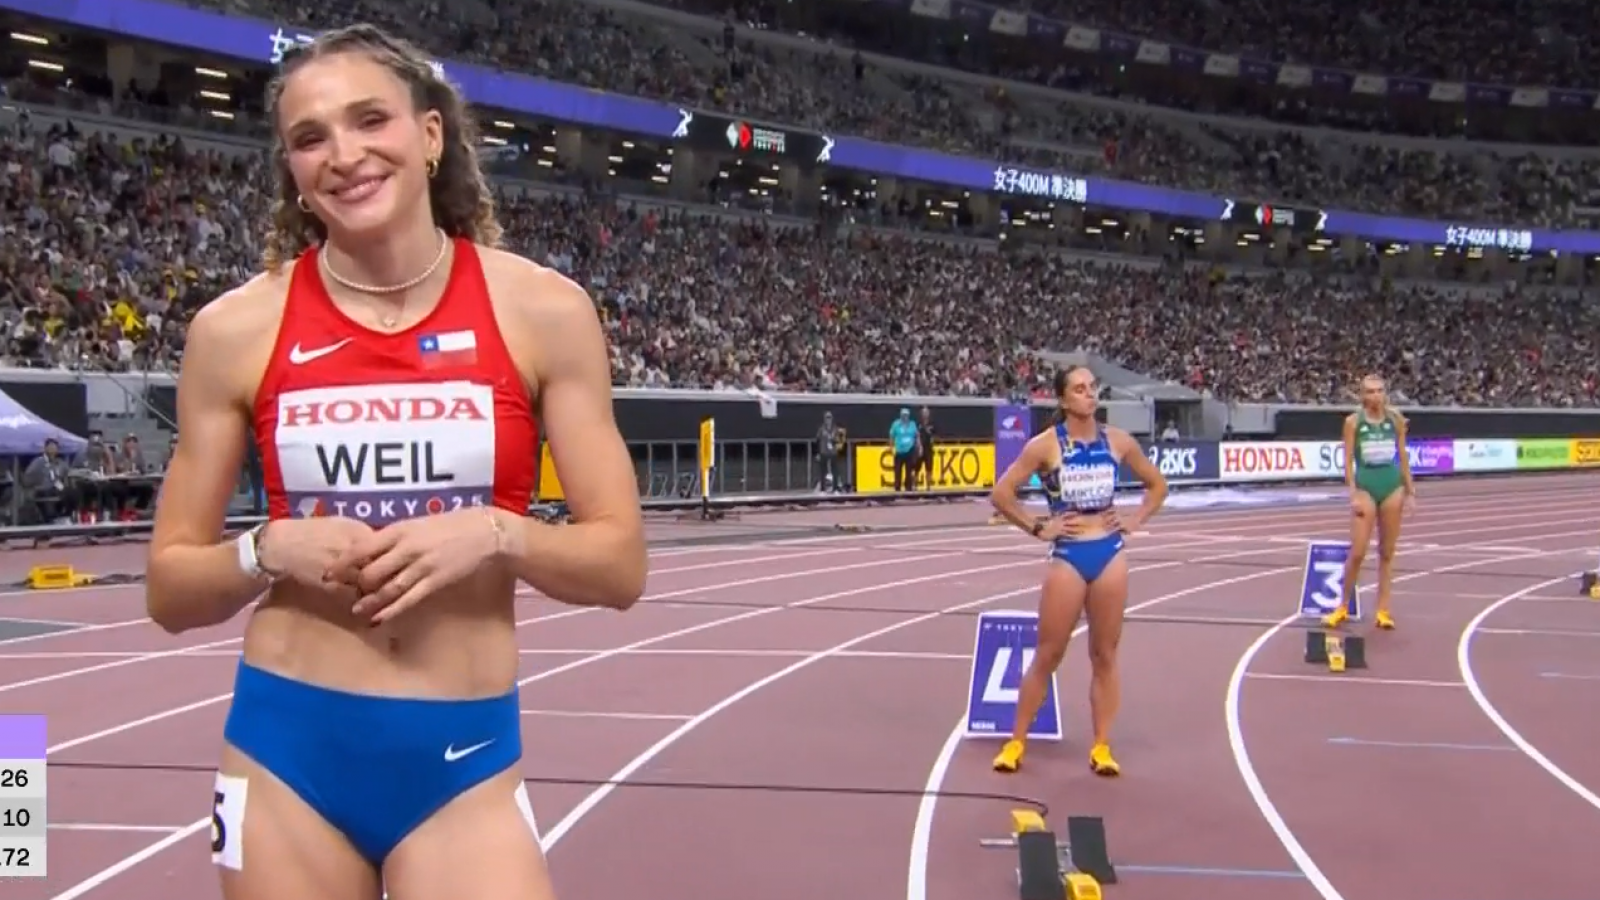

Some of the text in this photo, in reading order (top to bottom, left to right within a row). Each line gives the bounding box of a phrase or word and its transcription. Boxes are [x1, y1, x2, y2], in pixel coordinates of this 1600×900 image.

[993, 166, 1049, 196] 女子400M
[282, 397, 487, 427] HONDA
[315, 441, 455, 486] WEIL
[1160, 447, 1197, 475] asics
[1224, 447, 1306, 473] HONDA
[1311, 562, 1345, 608] 3
